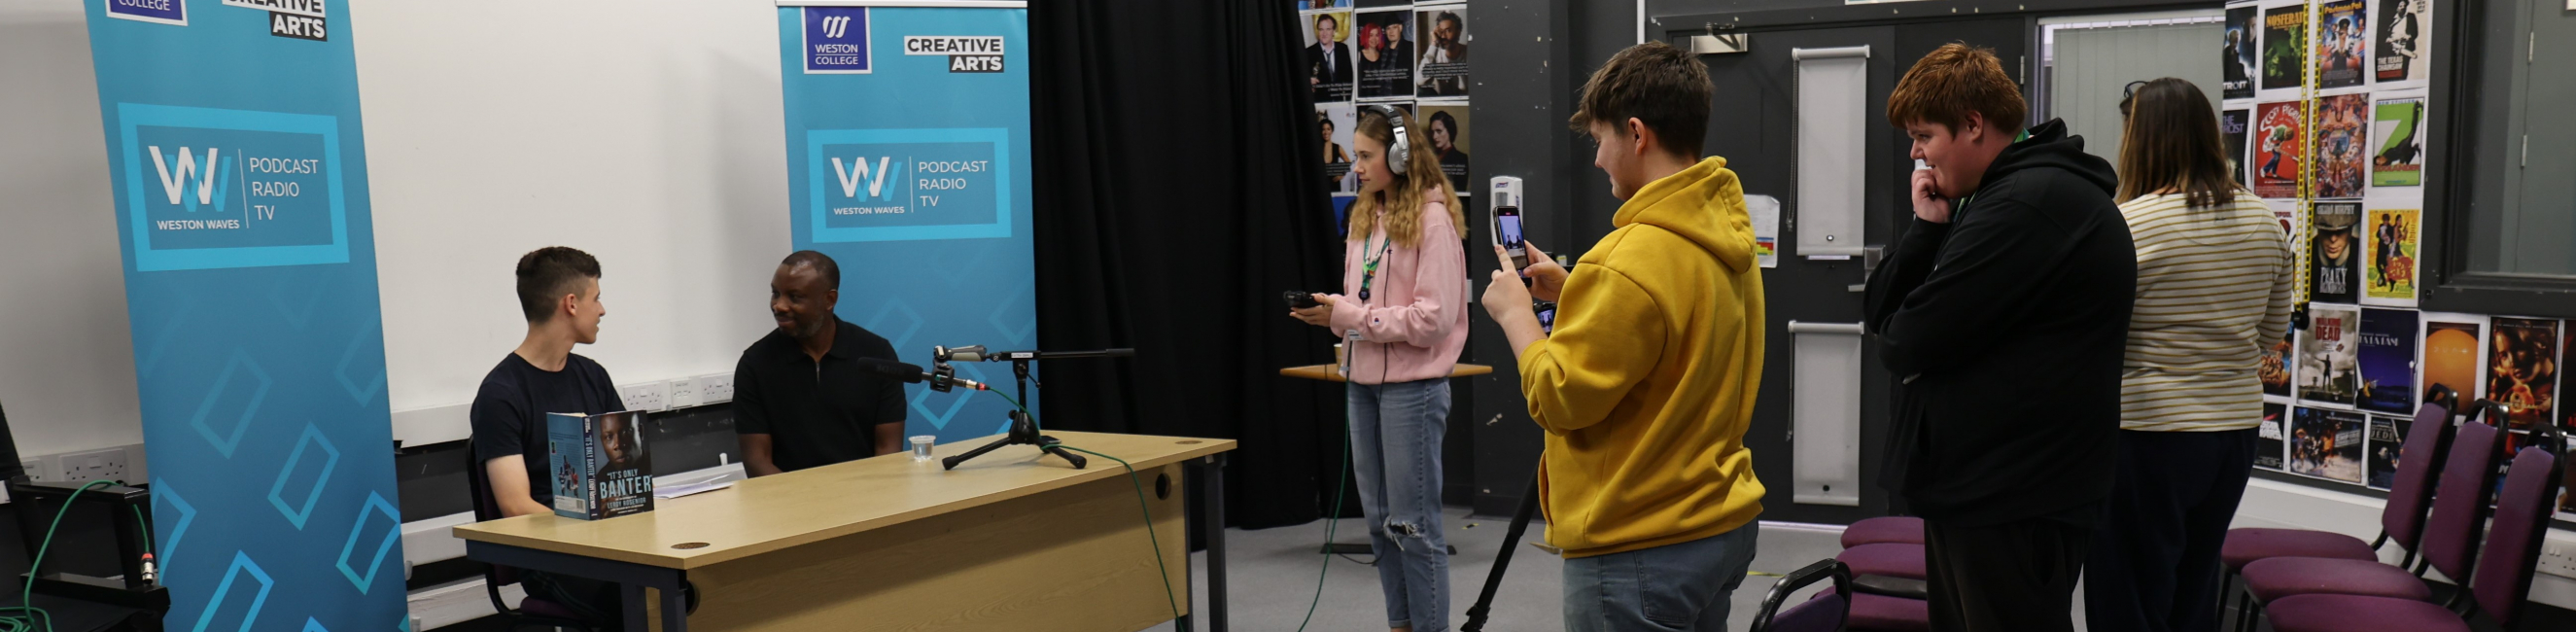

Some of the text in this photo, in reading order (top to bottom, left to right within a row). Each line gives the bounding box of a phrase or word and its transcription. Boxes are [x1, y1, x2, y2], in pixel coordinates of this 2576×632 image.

[229, 0, 322, 14] ATIVE
[272, 15, 325, 38] ARTS
[2266, 12, 2304, 27] NOSFERAT
[815, 44, 858, 53] WESTON
[907, 38, 1001, 53] CREATIVE
[815, 55, 858, 65] COLLEGE
[952, 55, 1002, 71] ARTS
[2223, 81, 2247, 89] TROIT
[250, 158, 319, 174] PODCAST
[919, 160, 988, 173] PODCAST
[252, 181, 299, 197] RADIO
[920, 178, 966, 191] RADIO
[920, 195, 939, 207] TV
[254, 205, 275, 221] TV
[157, 219, 240, 230] WESTON WAVES
[2315, 326, 2341, 341] DEAD
[622, 468, 639, 478] ONLY
